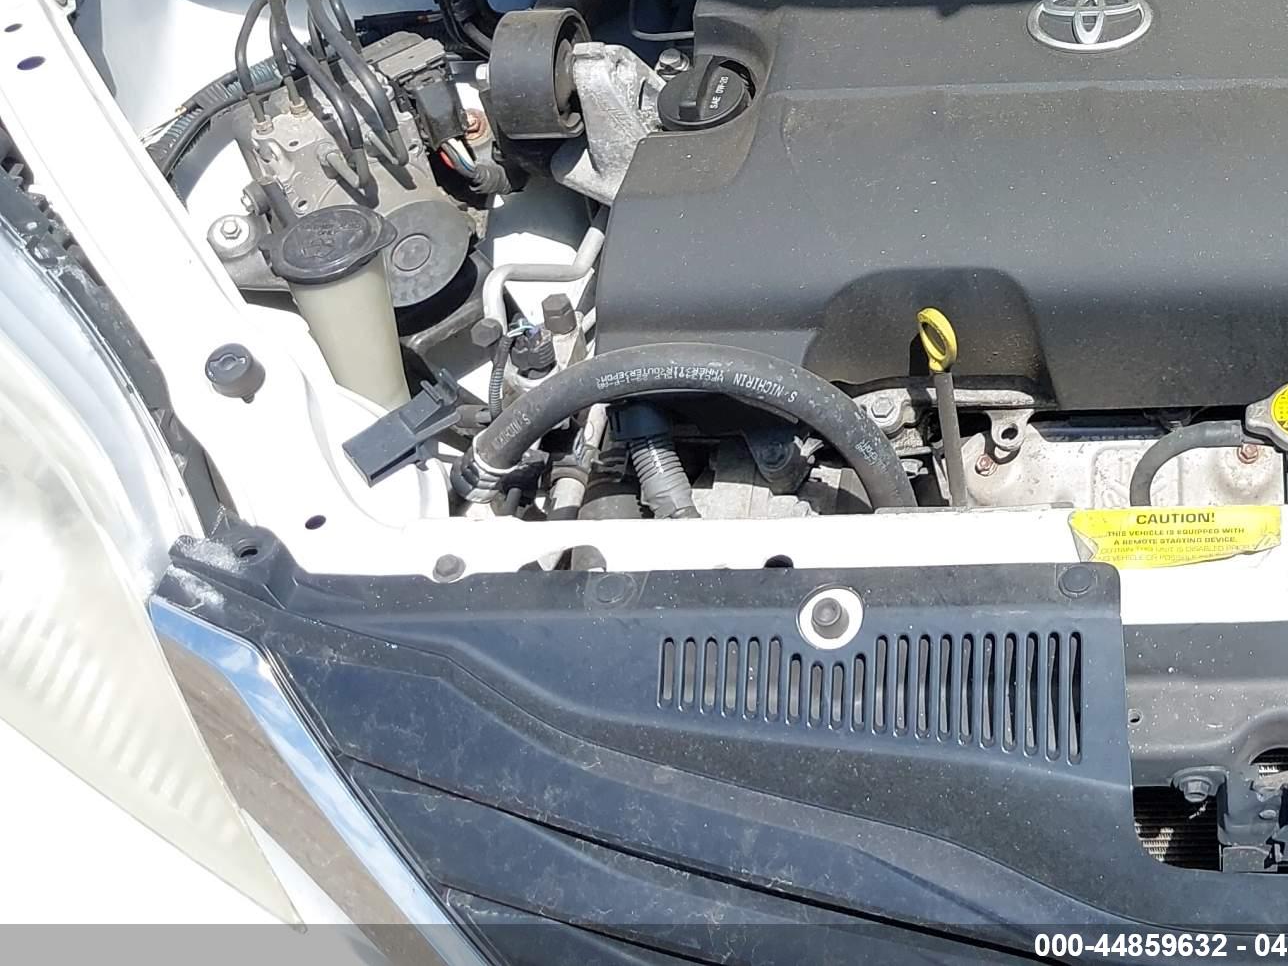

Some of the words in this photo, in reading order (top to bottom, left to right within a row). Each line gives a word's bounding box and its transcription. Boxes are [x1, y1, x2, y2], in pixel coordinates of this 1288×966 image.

[709, 96, 721, 109] SAE
[1136, 512, 1216, 525] CAUTION!
[1128, 529, 1164, 537] VEHICLE
